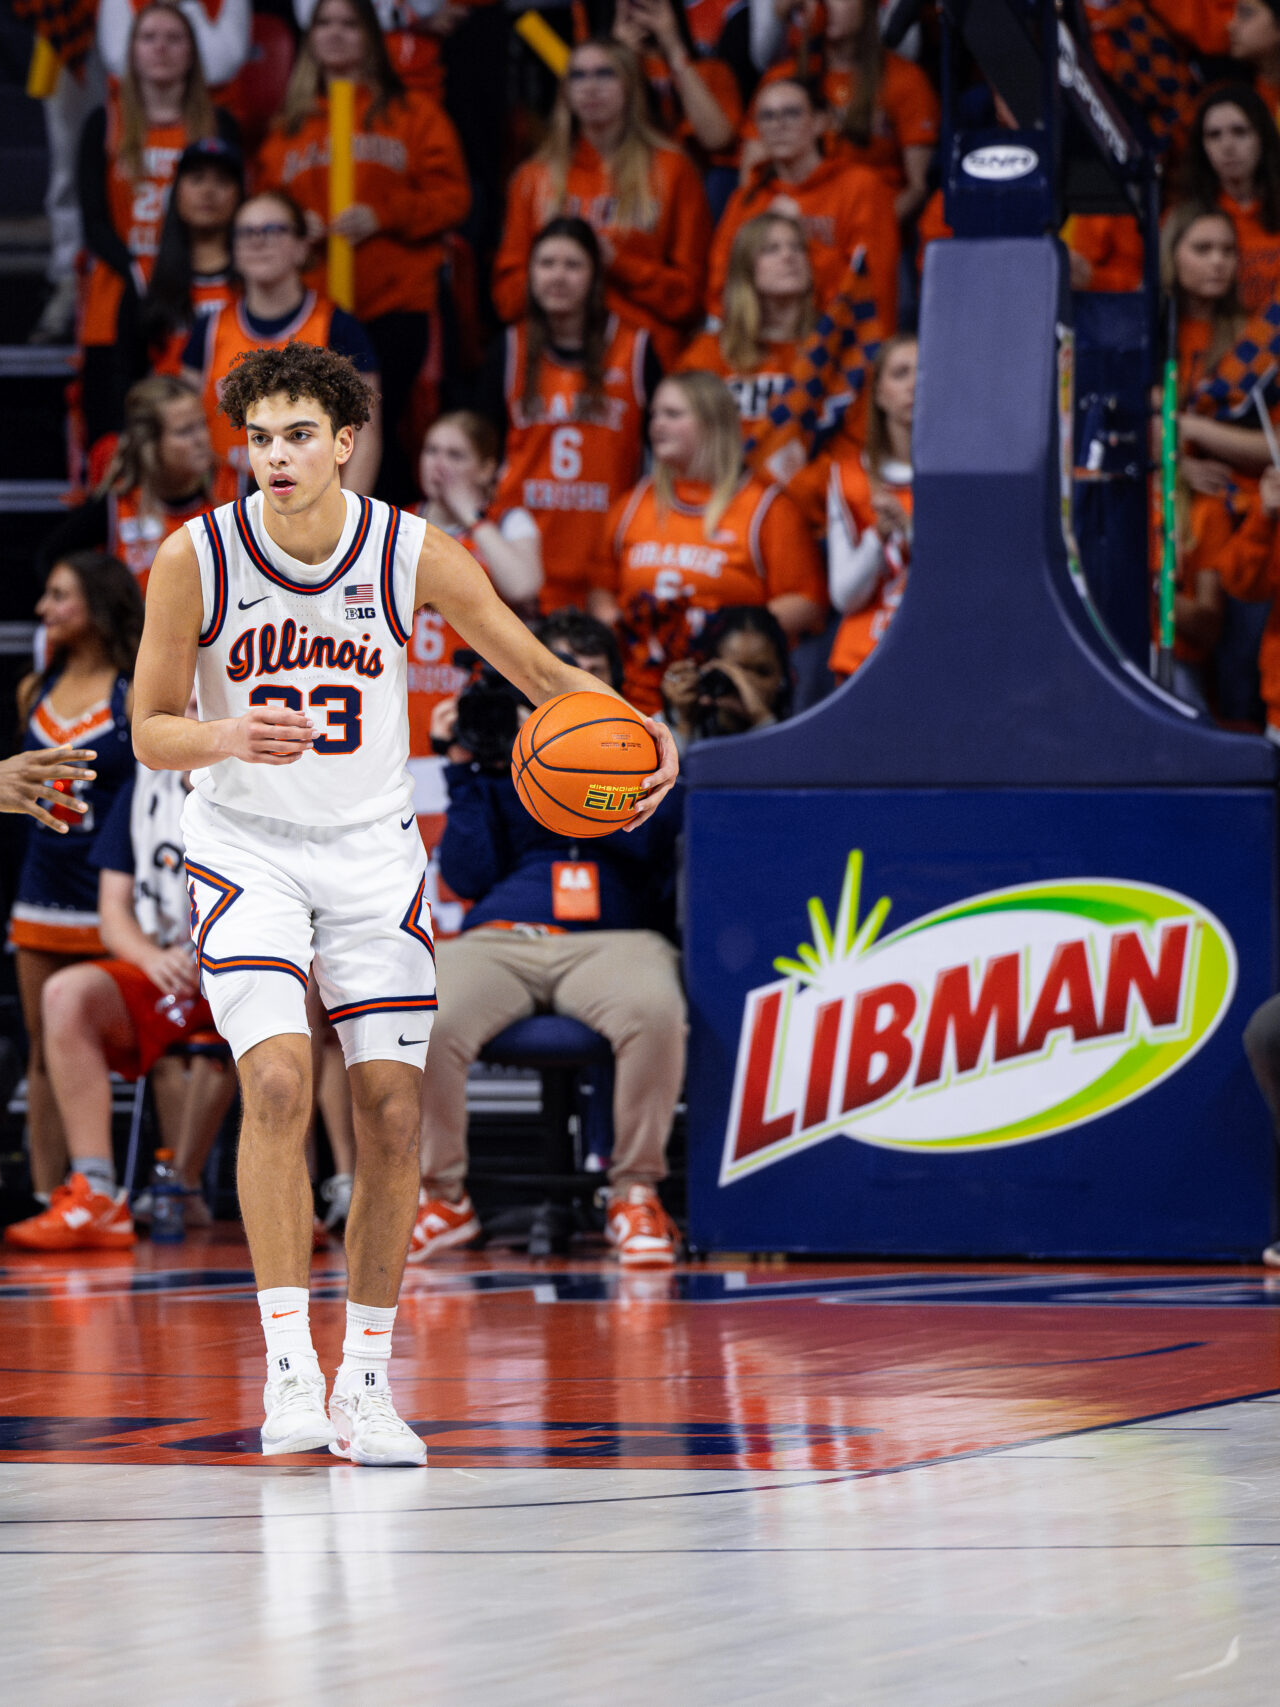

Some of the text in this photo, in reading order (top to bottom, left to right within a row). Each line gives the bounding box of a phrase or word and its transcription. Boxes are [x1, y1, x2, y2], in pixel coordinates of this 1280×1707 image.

[551, 426, 583, 481] 6
[226, 618, 384, 683] Illinois
[413, 607, 445, 662] 6
[728, 922, 1192, 1165] LIBMAN
